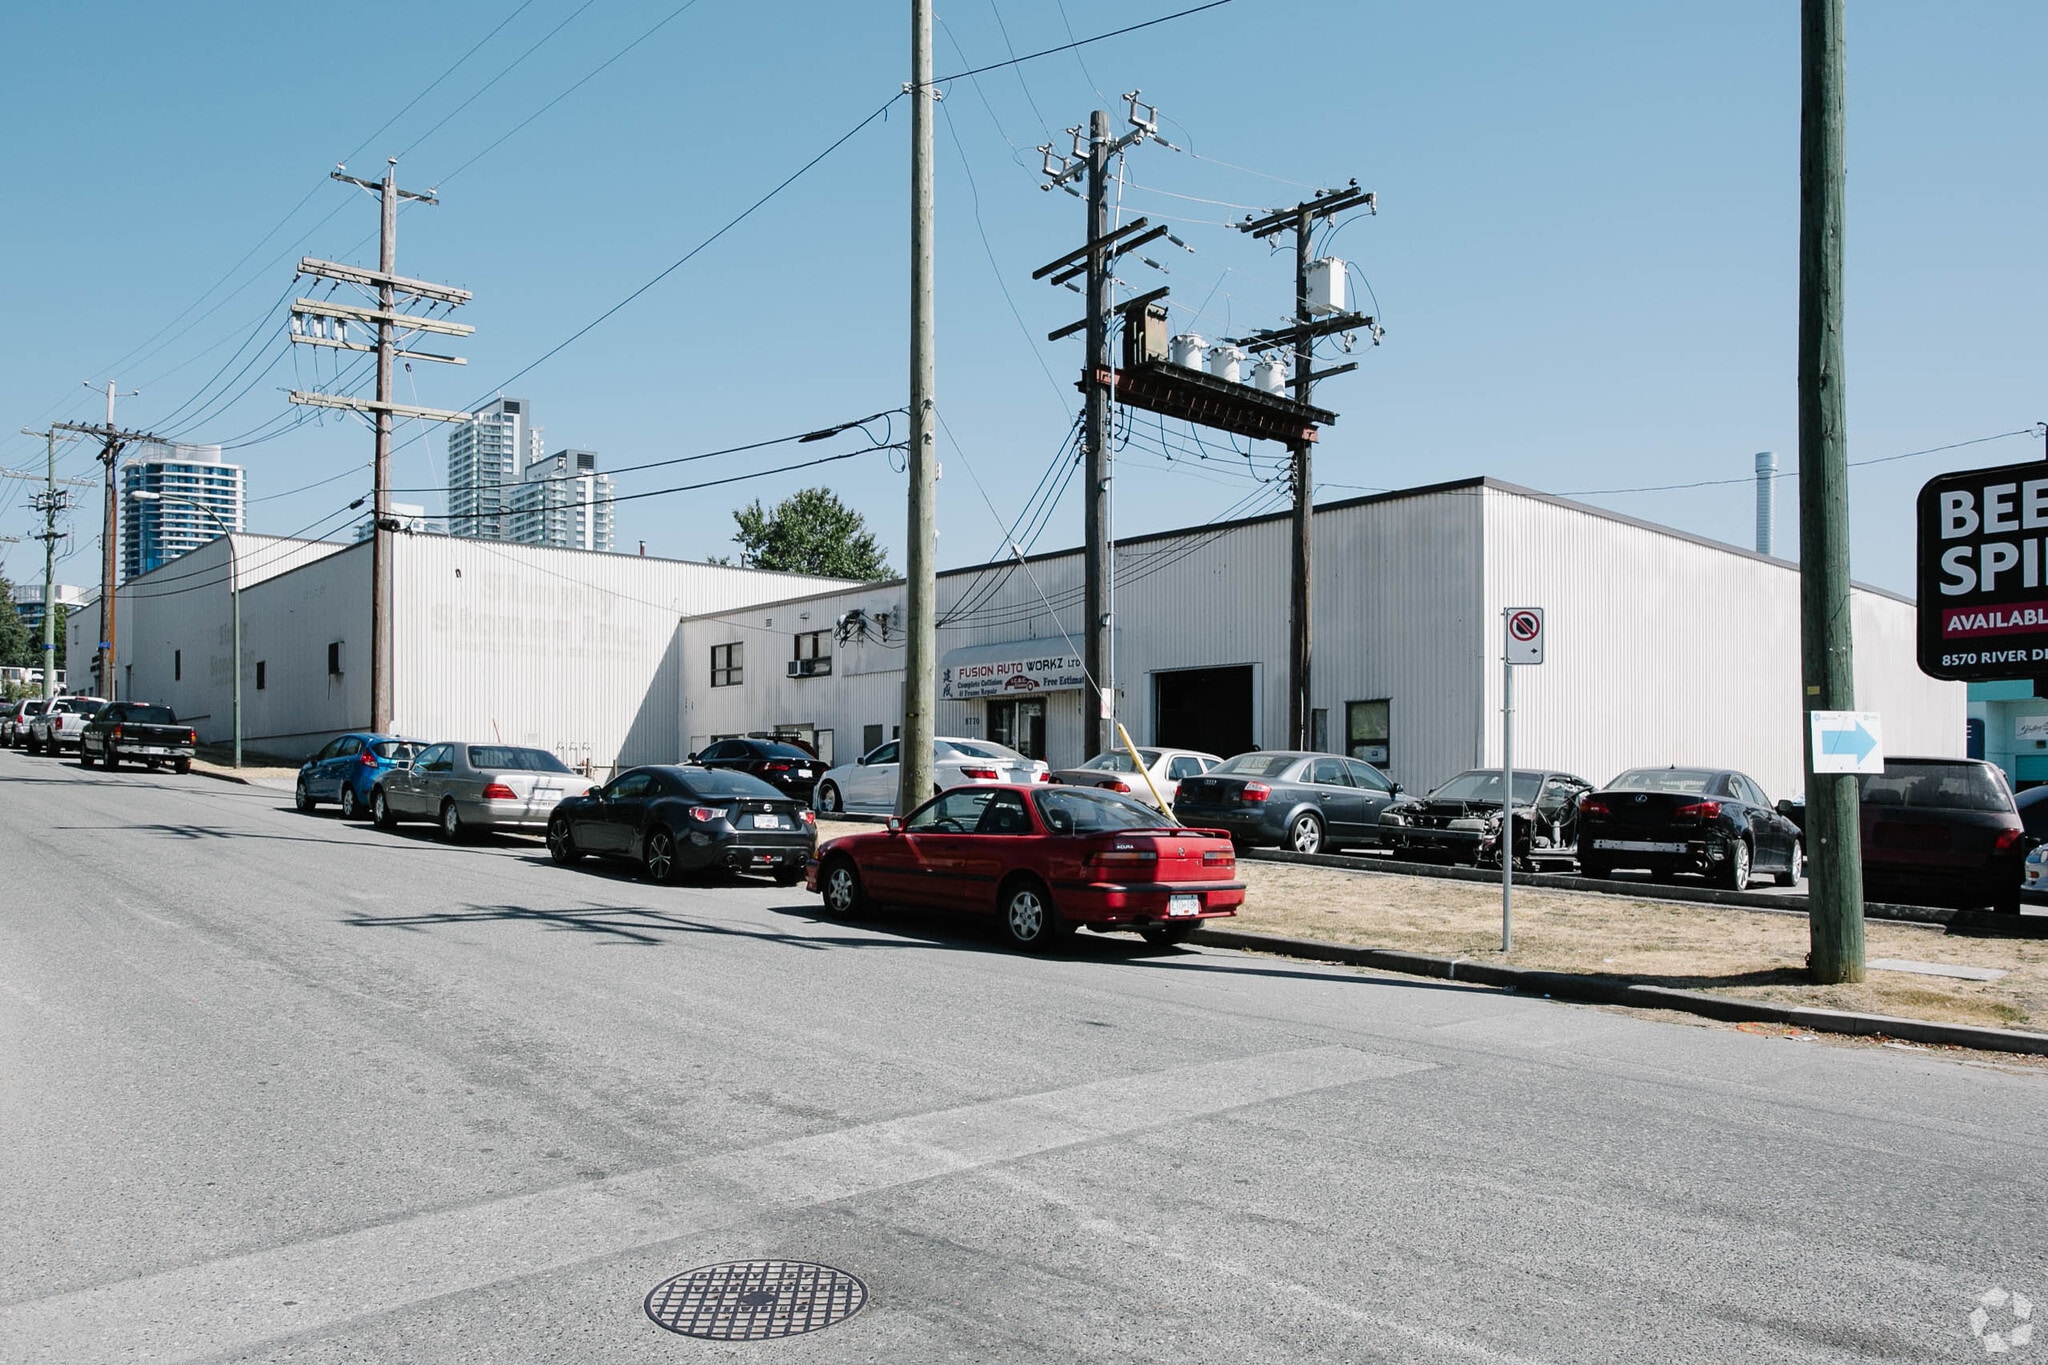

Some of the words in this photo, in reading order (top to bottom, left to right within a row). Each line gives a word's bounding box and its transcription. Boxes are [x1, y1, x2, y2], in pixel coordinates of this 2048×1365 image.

[1940, 478, 2048, 540] BEE
[1940, 537, 2048, 596] SPI
[1947, 608, 2048, 632] AVAILABL
[959, 665, 994, 680] FUSION
[997, 662, 1023, 675] AUTO
[1026, 657, 1063, 672] WORKZ
[1067, 659, 1081, 668] LTD
[1942, 653, 1977, 666] 8570
[1981, 649, 2028, 664] RIVER
[981, 687, 998, 697] Repair
[1043, 677, 1058, 687] Free
